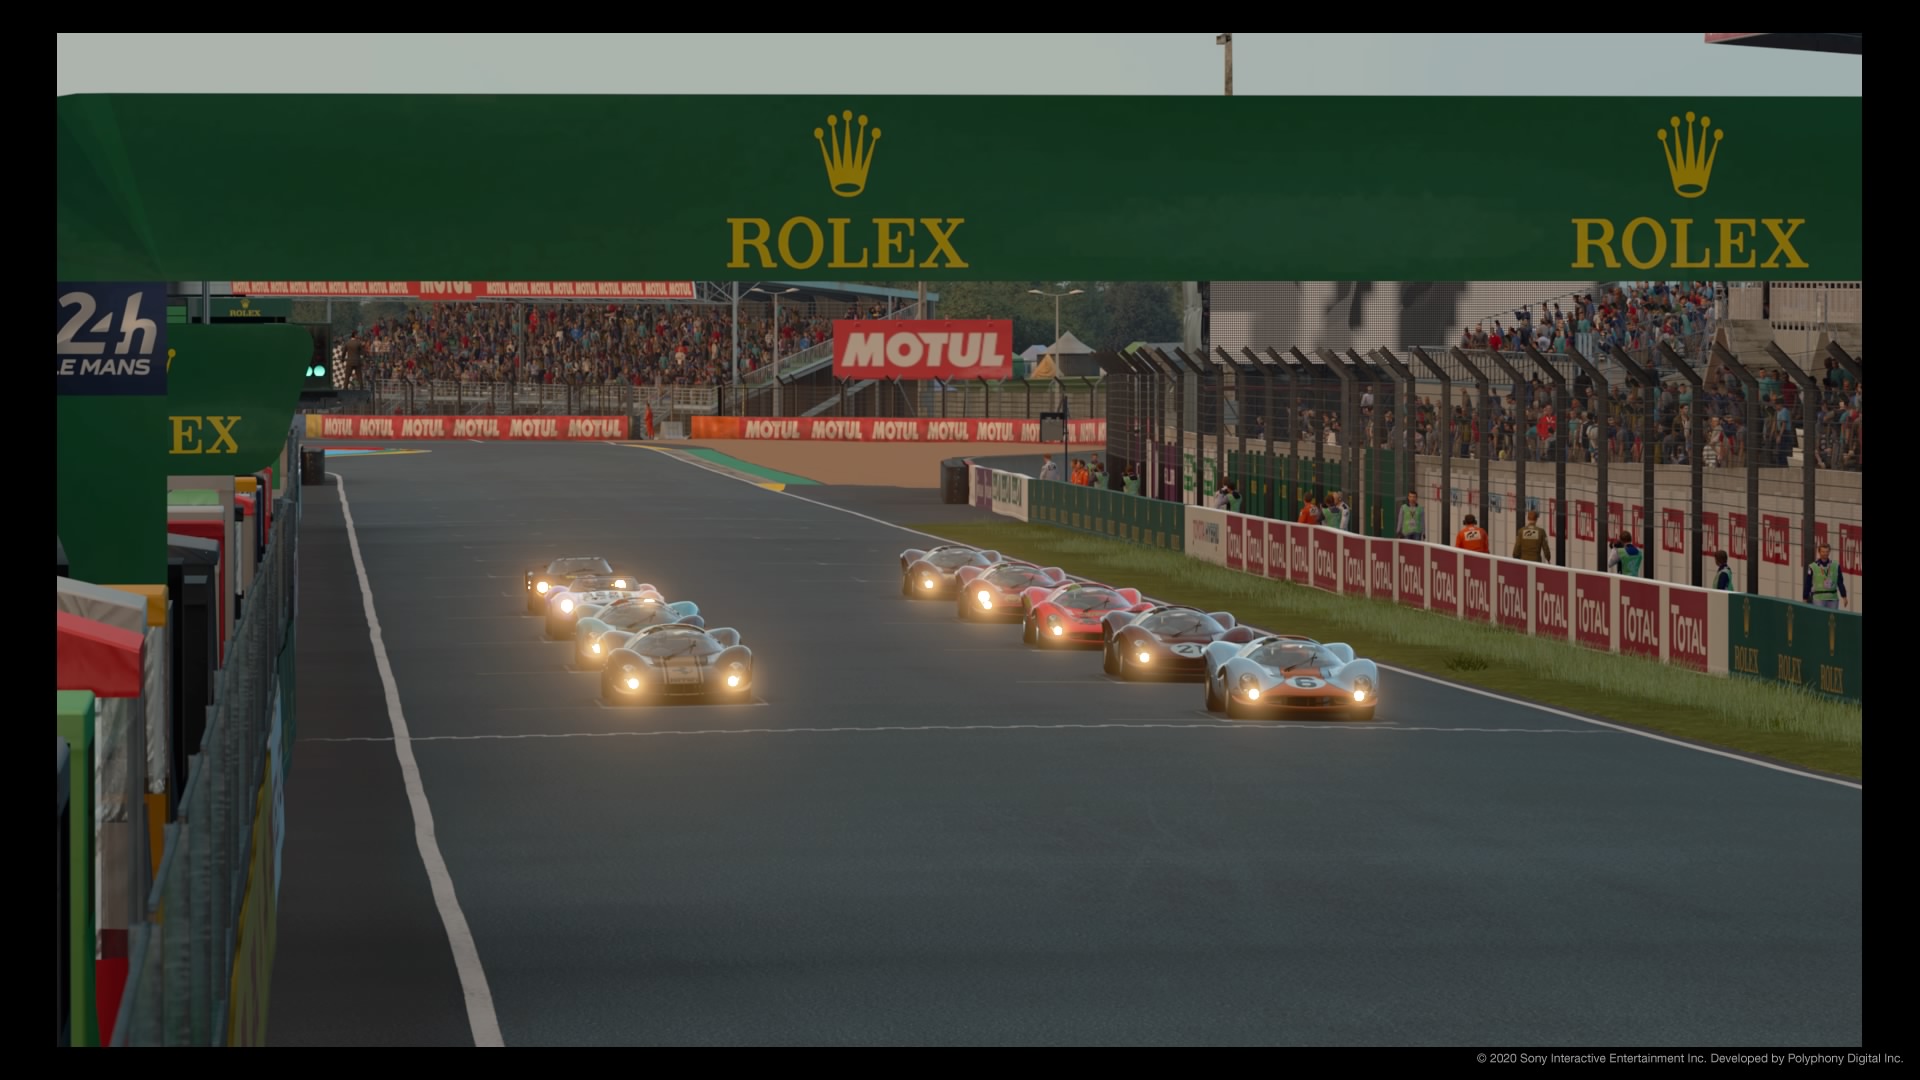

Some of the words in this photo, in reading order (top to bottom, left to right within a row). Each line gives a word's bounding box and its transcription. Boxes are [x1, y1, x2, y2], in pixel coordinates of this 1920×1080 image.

[728, 216, 968, 269] ROLEX
[1572, 217, 1808, 269] ROLEX
[486, 281, 507, 295] MOTUL
[508, 281, 529, 295] MOTUL
[530, 281, 551, 295] MOTUL
[553, 281, 574, 295] MOTUL
[576, 281, 597, 295] MOTUL
[599, 281, 620, 295] MOTUL
[622, 281, 644, 295] MOTUL
[645, 281, 667, 295] MOTUL
[669, 281, 692, 295] MOTUL
[57, 292, 157, 354] 24h
[80, 359, 151, 376] MANS
[841, 332, 1005, 367] MOTUL
[324, 418, 352, 437] MOTUL
[359, 418, 394, 437] MOTUL
[402, 418, 444, 437] MOTUL
[454, 418, 500, 437] MOTUL
[509, 418, 558, 437] MOTUL
[568, 418, 622, 437] MOTUL
[745, 420, 800, 440] MOTUL
[811, 420, 862, 440] MOTUL
[872, 420, 919, 440] MOTUL
[928, 420, 968, 440] MOTUL
[976, 420, 1014, 440] MOTUL
[1228, 526, 1242, 559] TOTAL
[1247, 530, 1264, 564] TOTAL
[1268, 534, 1286, 568] TOTAL
[1291, 538, 1308, 572] TOTAL
[1314, 540, 1336, 580] TOTAL
[1344, 549, 1366, 587] TOTAL
[1372, 553, 1392, 591] TOTAL
[1400, 556, 1424, 596] TOTAL
[1432, 562, 1456, 602] TOTAL
[1464, 568, 1489, 612] TOTAL
[1498, 575, 1526, 620] TOTAL
[1537, 582, 1567, 629] TOTAL
[1576, 588, 1610, 637] TOTAL
[1621, 595, 1658, 647] TOTAL
[1671, 604, 1706, 656] TOTAL
[1734, 646, 1759, 674] ROLEX
[1778, 654, 1802, 684] ROLEX
[1820, 664, 1844, 694] ROLEX
[1294, 677, 1317, 688] 6
